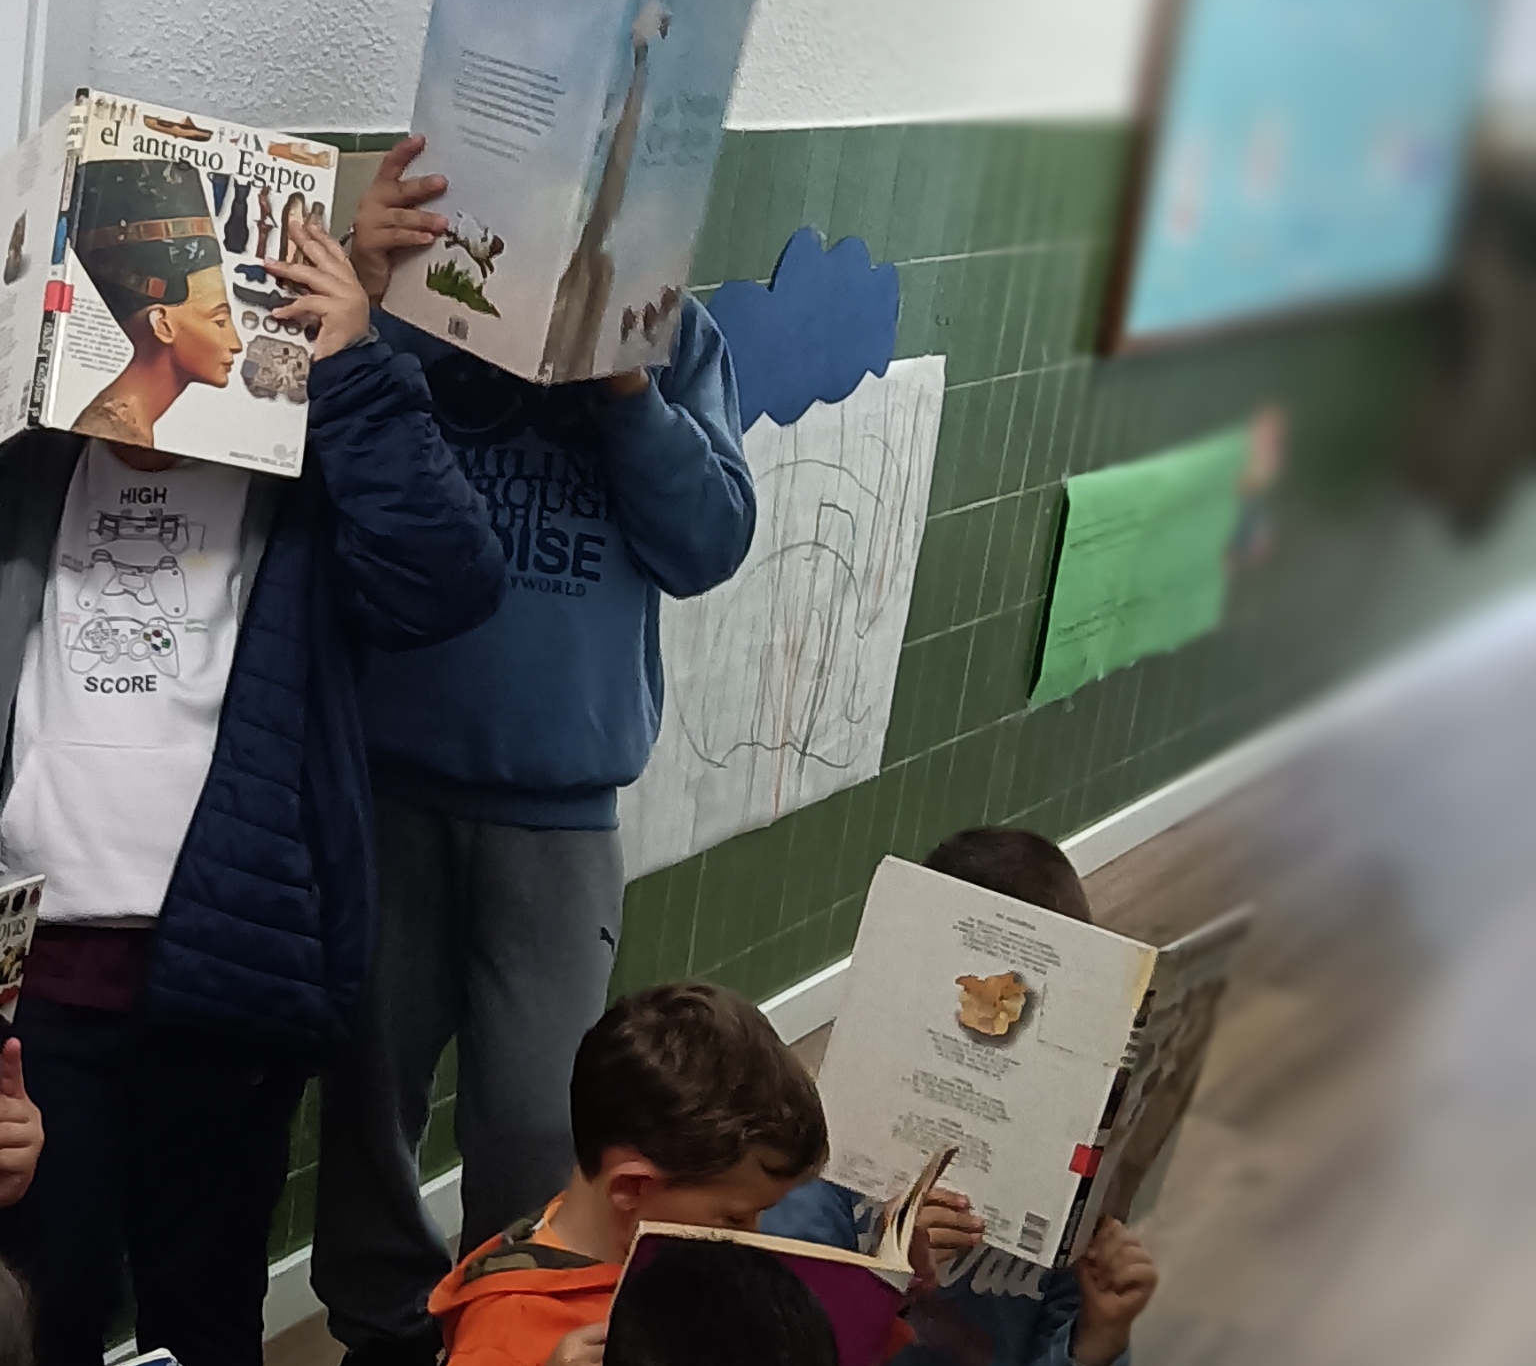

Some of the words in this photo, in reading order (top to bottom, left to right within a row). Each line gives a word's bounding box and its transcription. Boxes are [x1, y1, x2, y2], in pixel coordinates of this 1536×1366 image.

[100, 120, 120, 147] el
[131, 133, 224, 172] antiguo
[237, 149, 317, 193] Egipto
[119, 487, 168, 506] HIGH
[83, 674, 158, 695] SCORE
